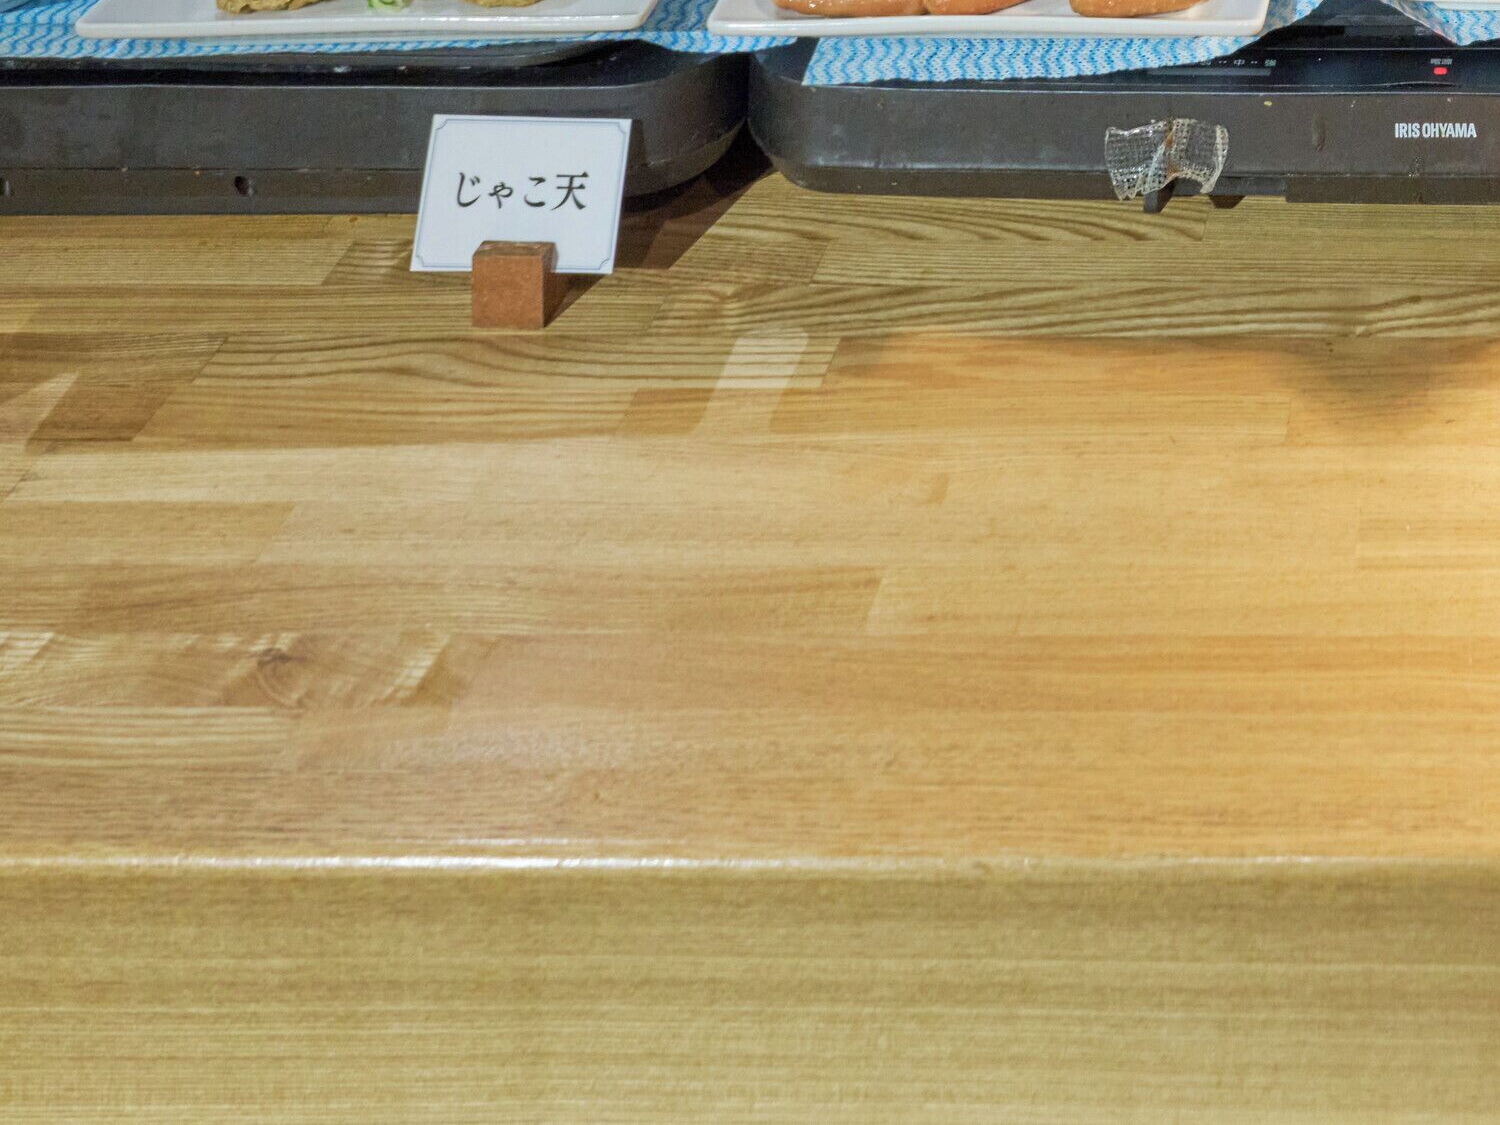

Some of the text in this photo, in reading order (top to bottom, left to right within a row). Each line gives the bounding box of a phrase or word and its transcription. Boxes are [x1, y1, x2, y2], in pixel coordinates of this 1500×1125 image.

[1394, 122, 1477, 138] IRIS OHYAMA
[456, 171, 589, 211] じゃこ天
